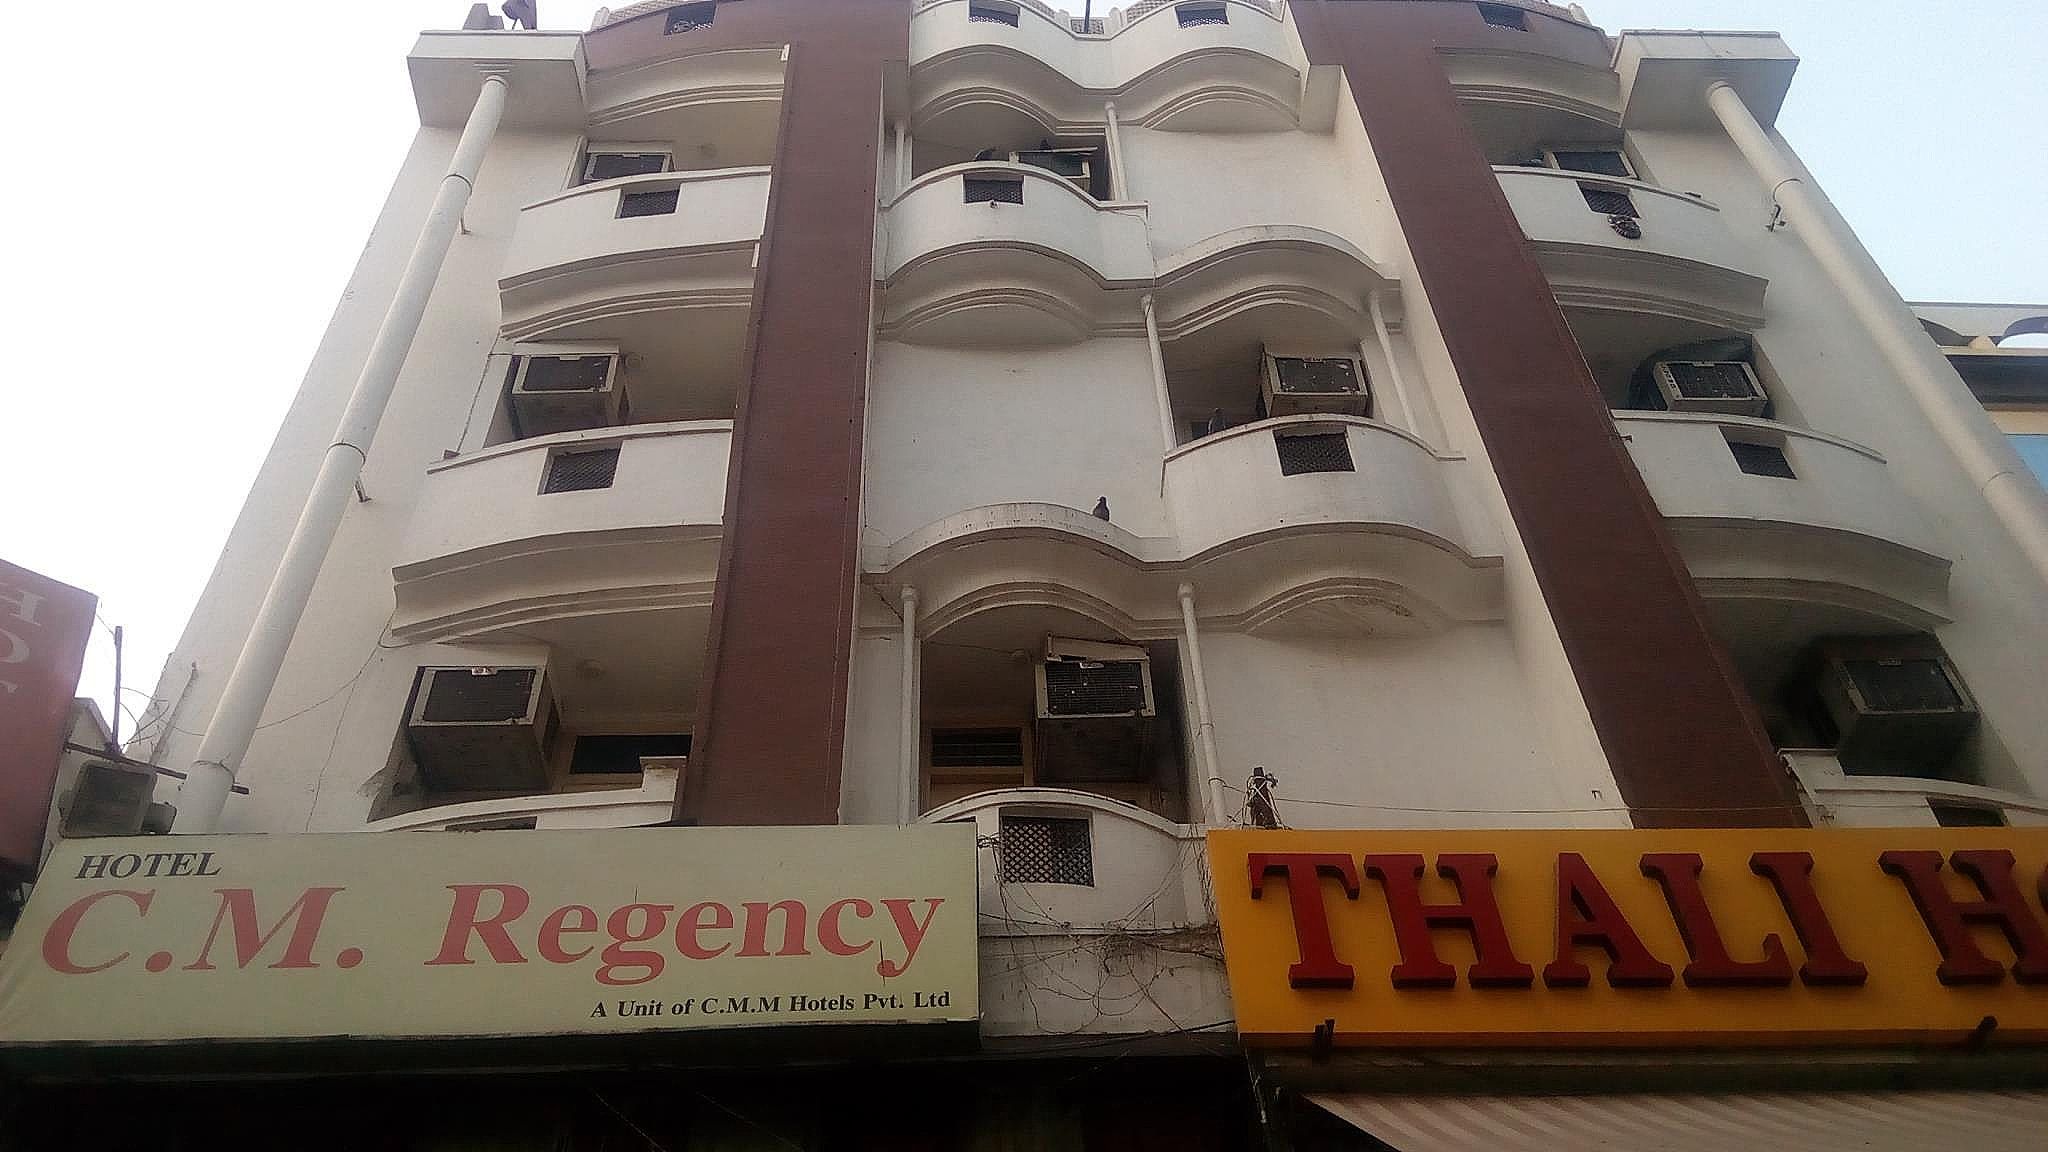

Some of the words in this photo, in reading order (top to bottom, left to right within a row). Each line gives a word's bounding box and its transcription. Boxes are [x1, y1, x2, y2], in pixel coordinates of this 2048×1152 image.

[75, 852, 222, 880] HOTEL
[41, 886, 366, 974] C.M.
[425, 883, 945, 986] Regency
[1247, 851, 1869, 990] THALI
[1877, 848, 2048, 990] H
[590, 1000, 608, 1019] A
[617, 998, 663, 1017] Unit
[671, 998, 695, 1018] of
[700, 994, 783, 1015] C.M.M
[788, 993, 855, 1012] Hotels
[863, 992, 905, 1010] Pvt.
[914, 990, 951, 1009] Ltd
